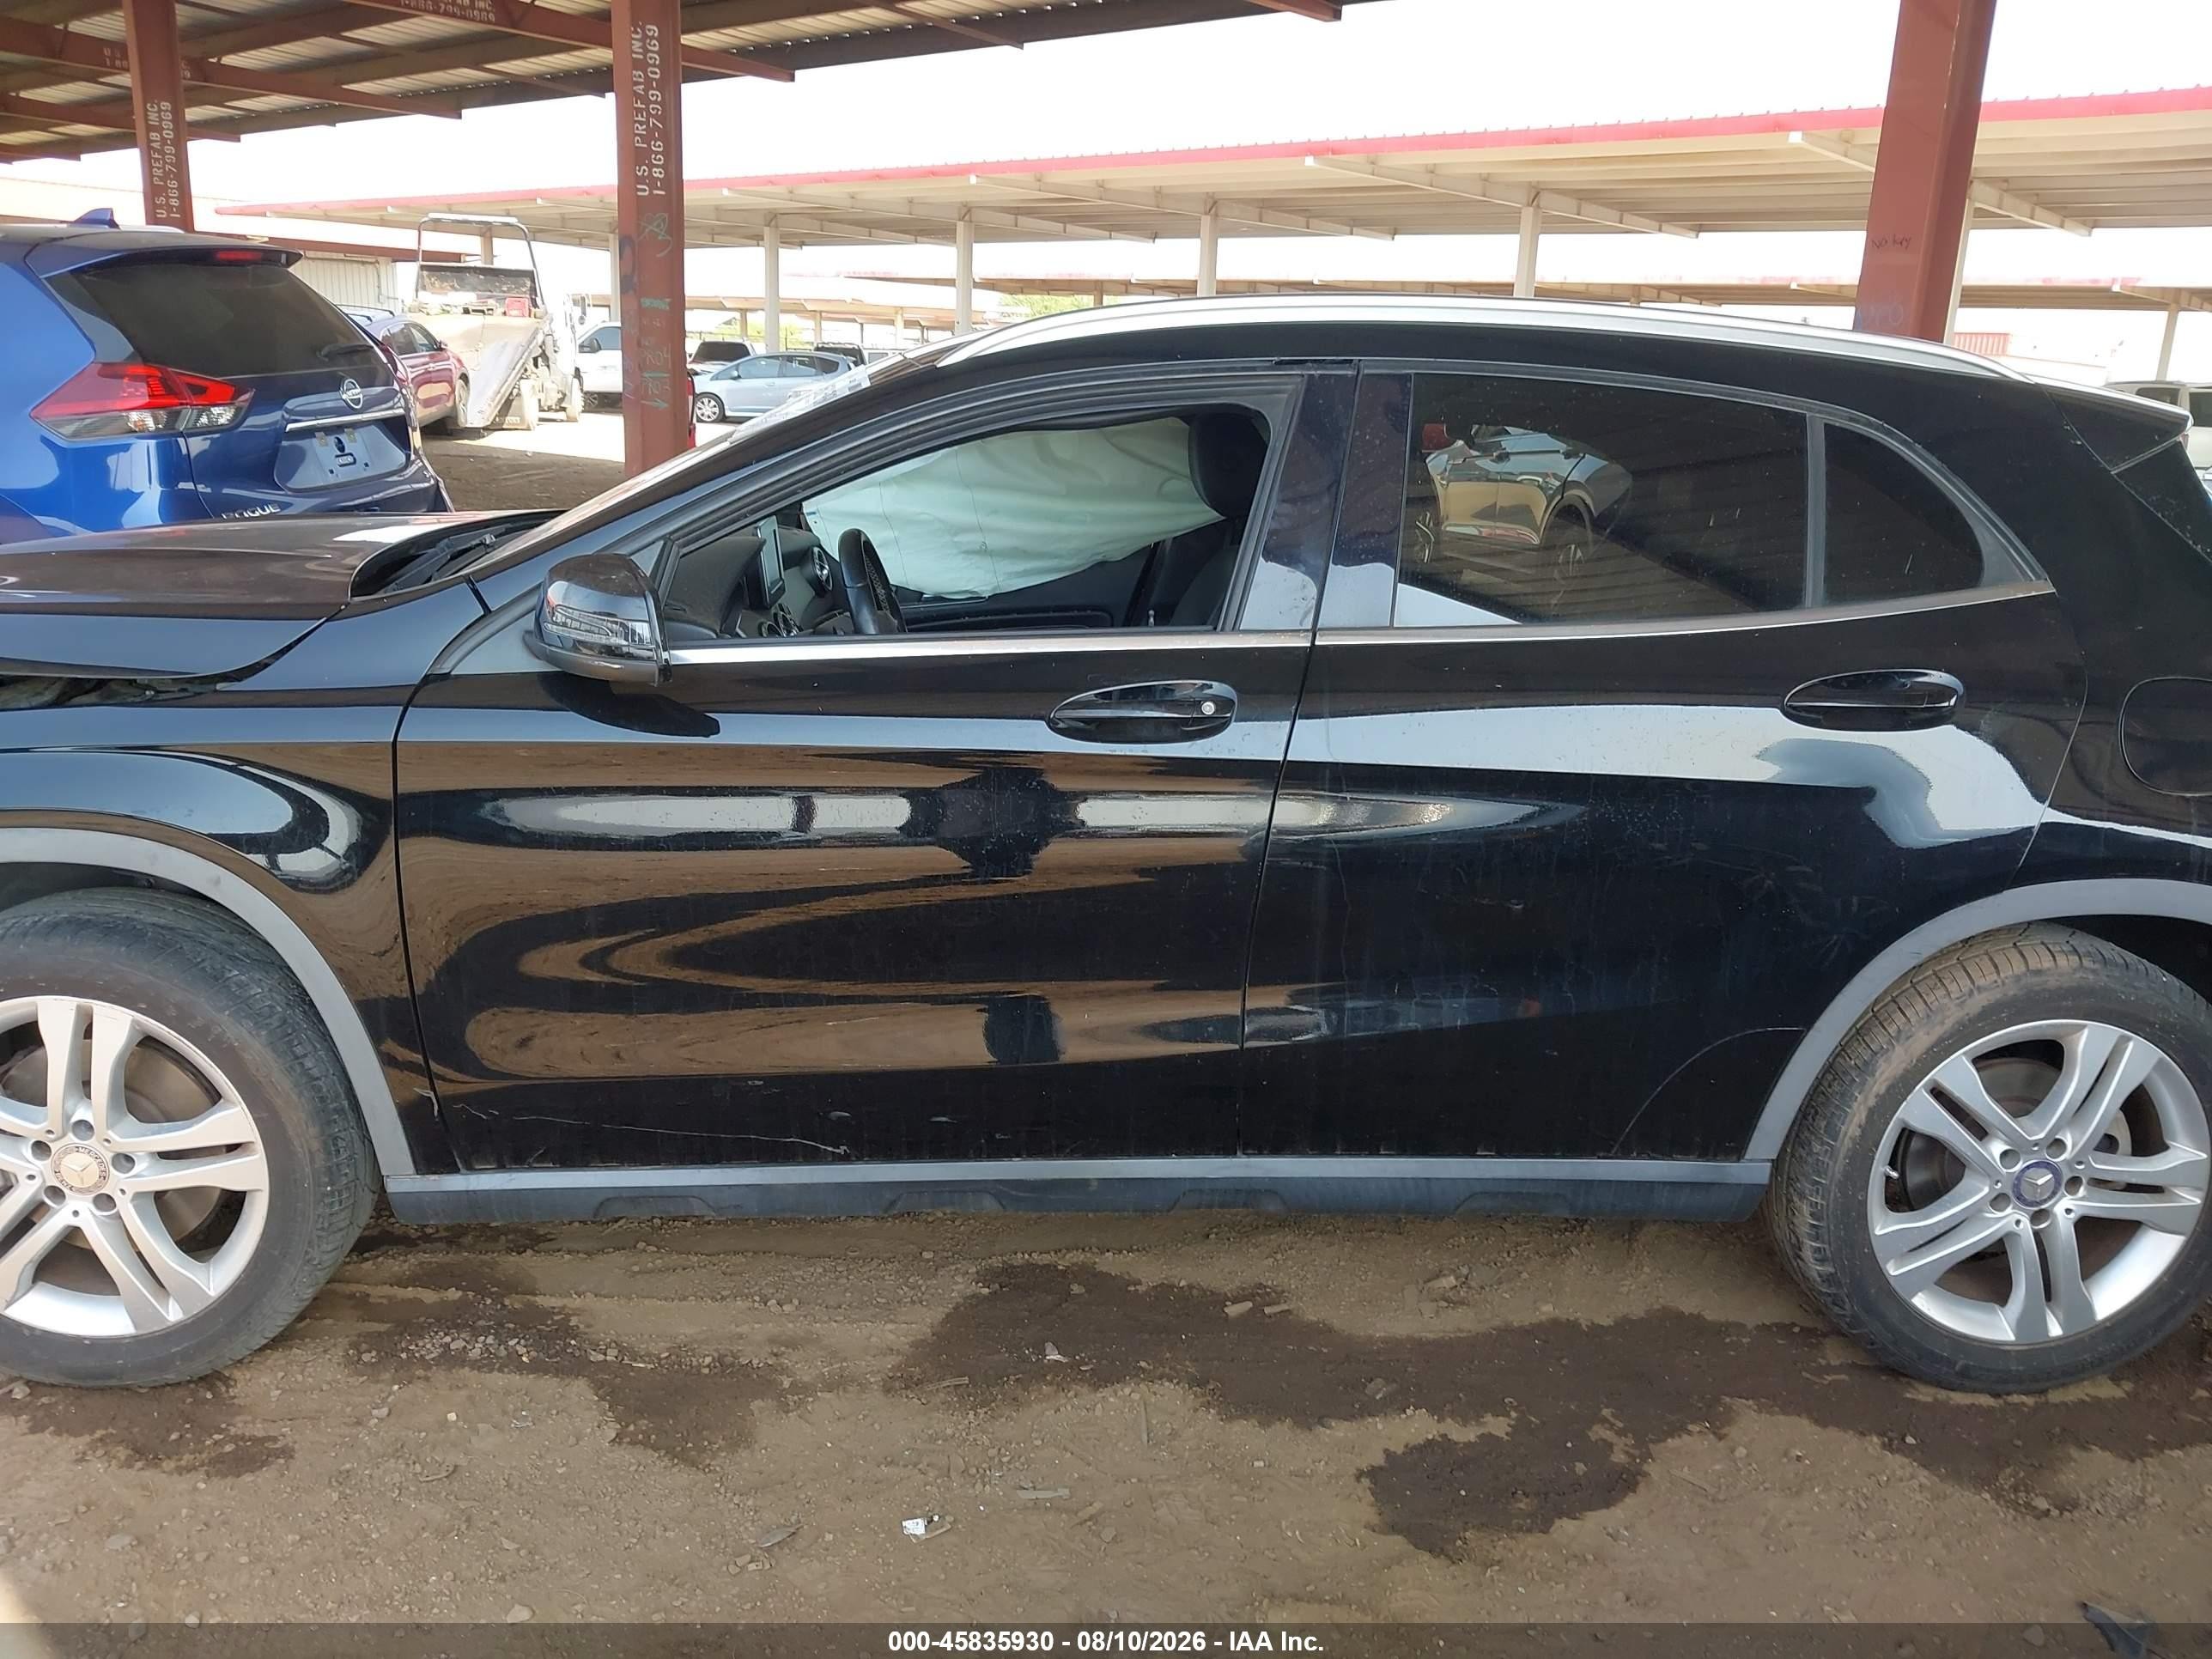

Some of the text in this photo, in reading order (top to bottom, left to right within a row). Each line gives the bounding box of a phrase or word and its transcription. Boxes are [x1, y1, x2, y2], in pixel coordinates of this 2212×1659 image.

[146, 100, 167, 218] U.S. PREFAB INC.
[160, 101, 181, 218] 1-866-799-0969
[630, 21, 649, 196] U.S. PREFAB INC.
[646, 24, 665, 196] 1-866-799-0969
